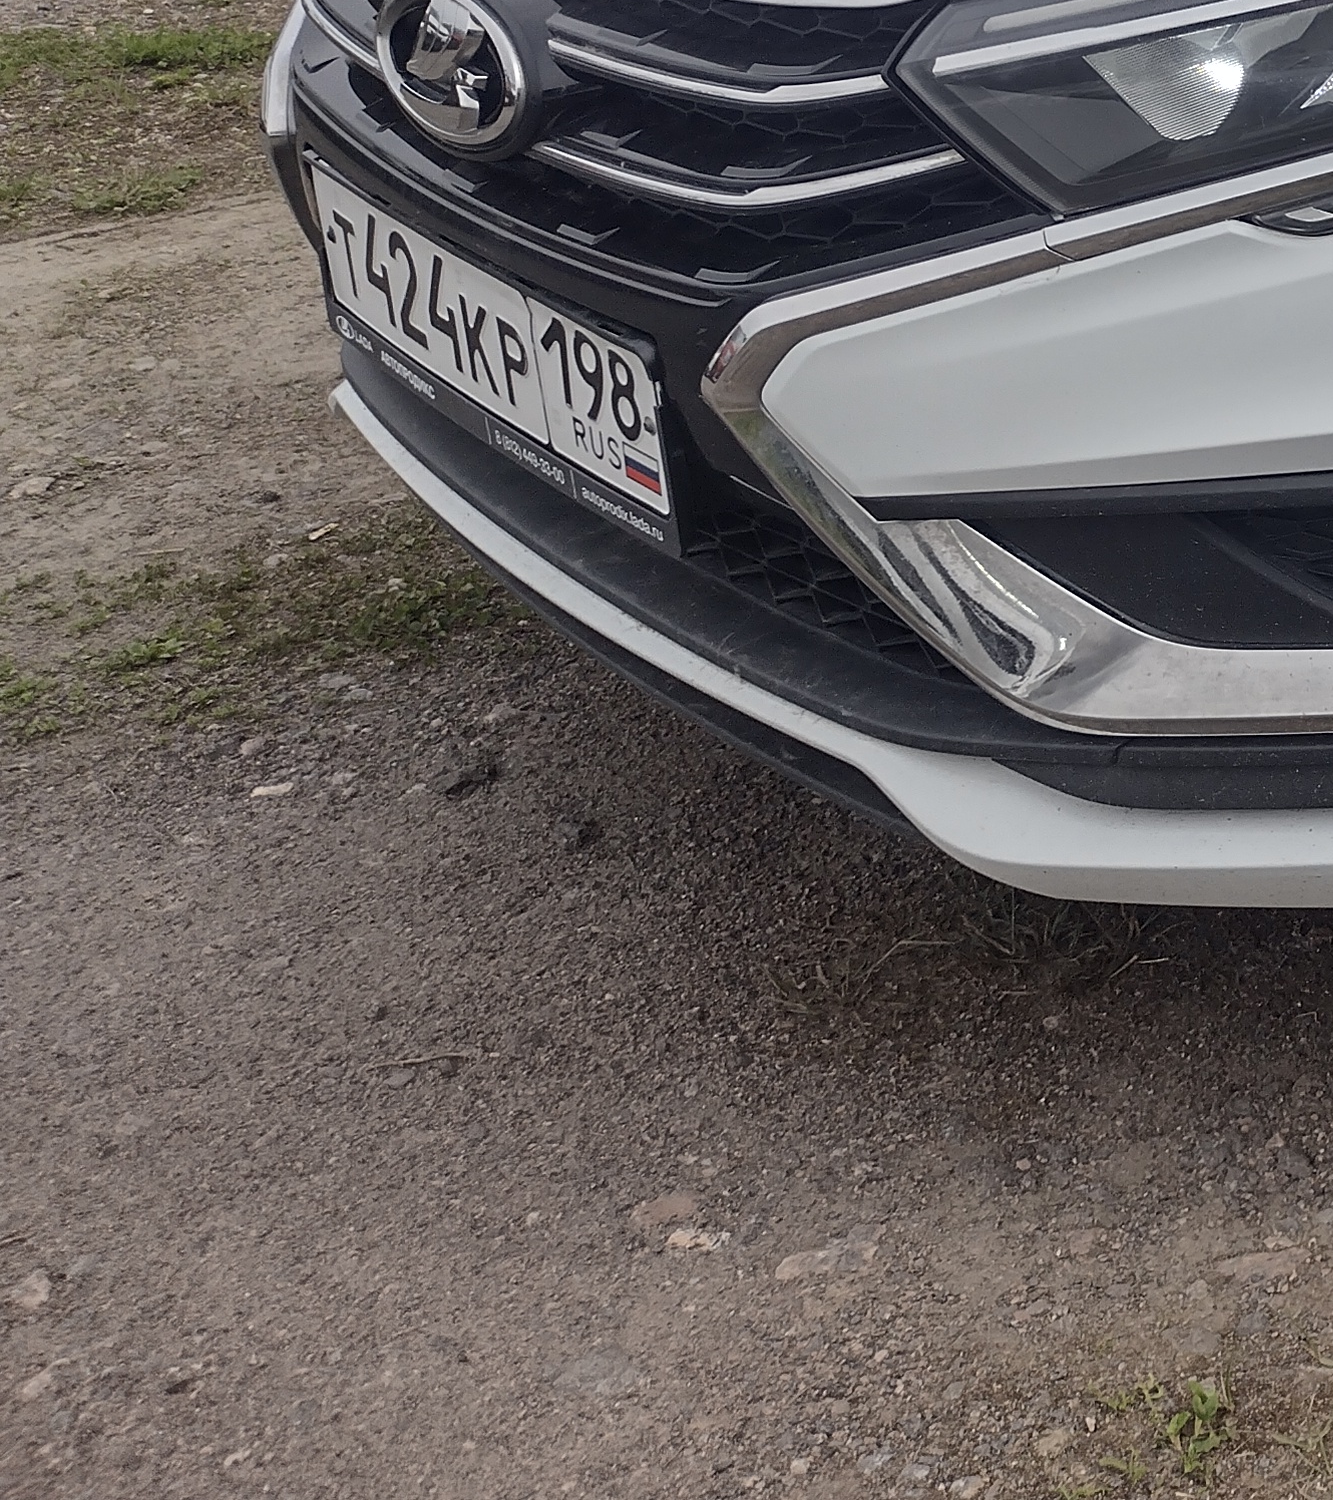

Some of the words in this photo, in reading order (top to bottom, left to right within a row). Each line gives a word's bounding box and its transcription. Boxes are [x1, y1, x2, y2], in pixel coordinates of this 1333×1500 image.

[355, 330, 374, 353] LADA
[381, 350, 436, 400] АВТОПРОДИКС
[541, 316, 641, 441] 198
[572, 416, 622, 470] RUS
